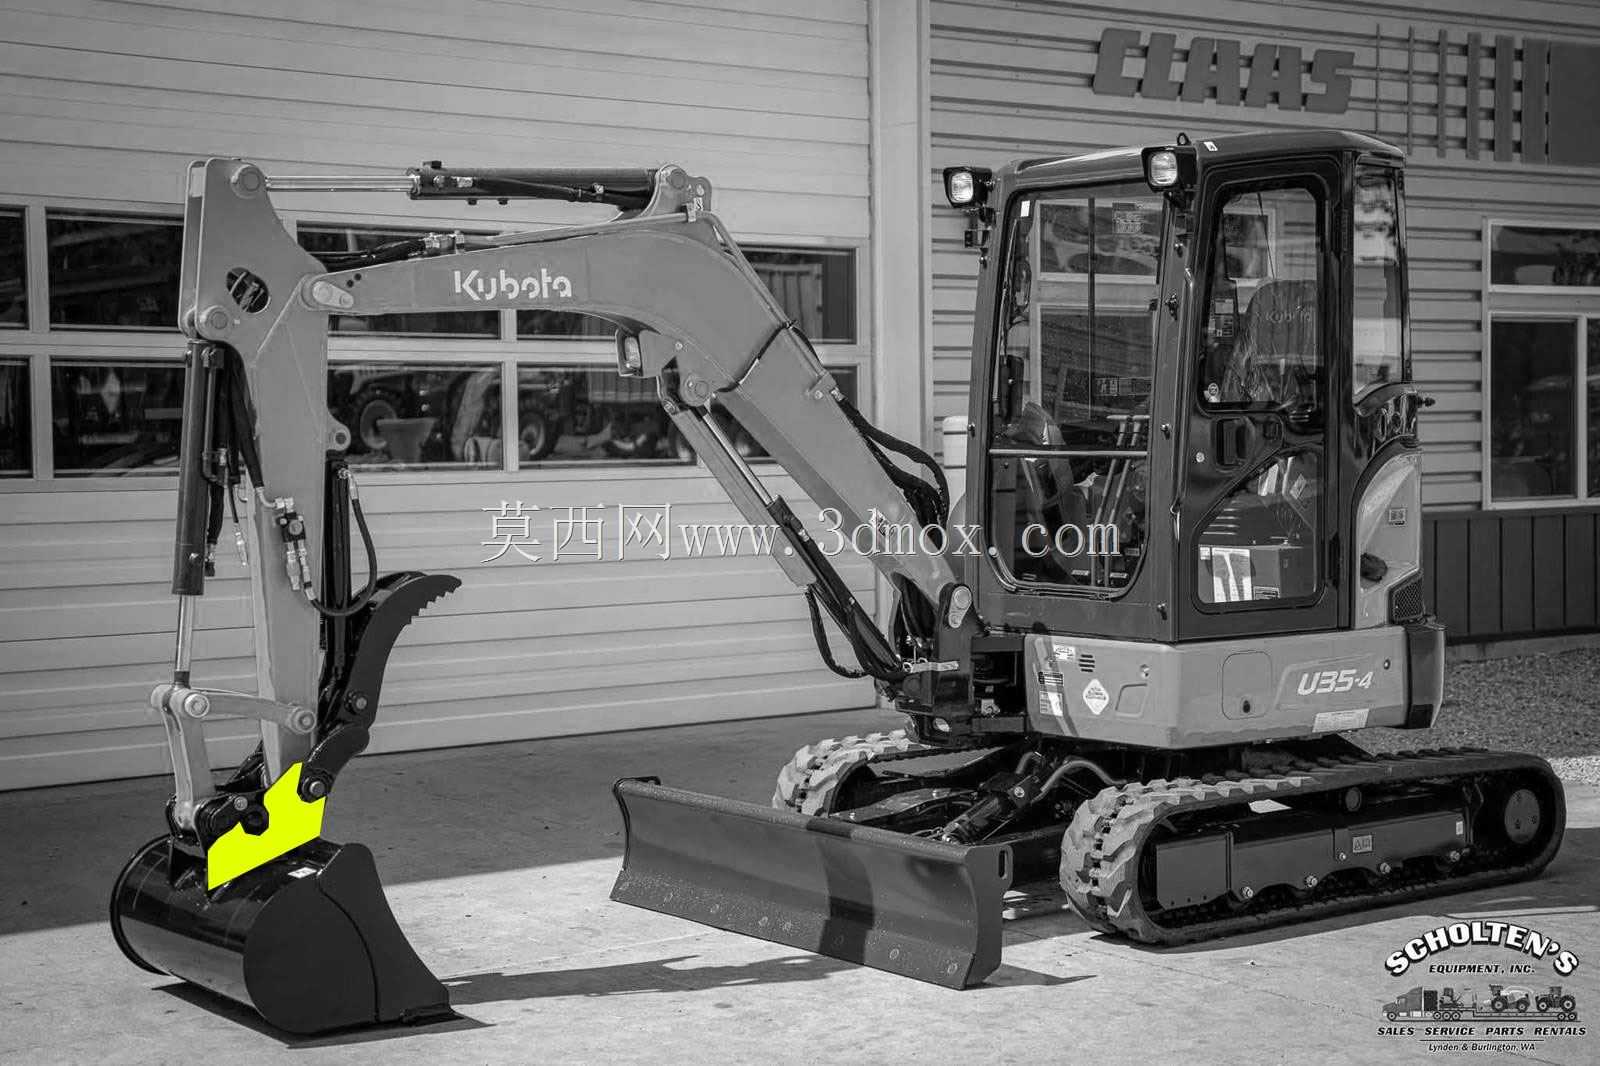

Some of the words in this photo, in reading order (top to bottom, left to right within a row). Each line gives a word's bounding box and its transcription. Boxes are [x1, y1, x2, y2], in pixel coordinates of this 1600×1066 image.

[1093, 27, 1355, 114] CLAAS
[454, 268, 572, 300] Kubota
[1298, 669, 1373, 696] U35-4
